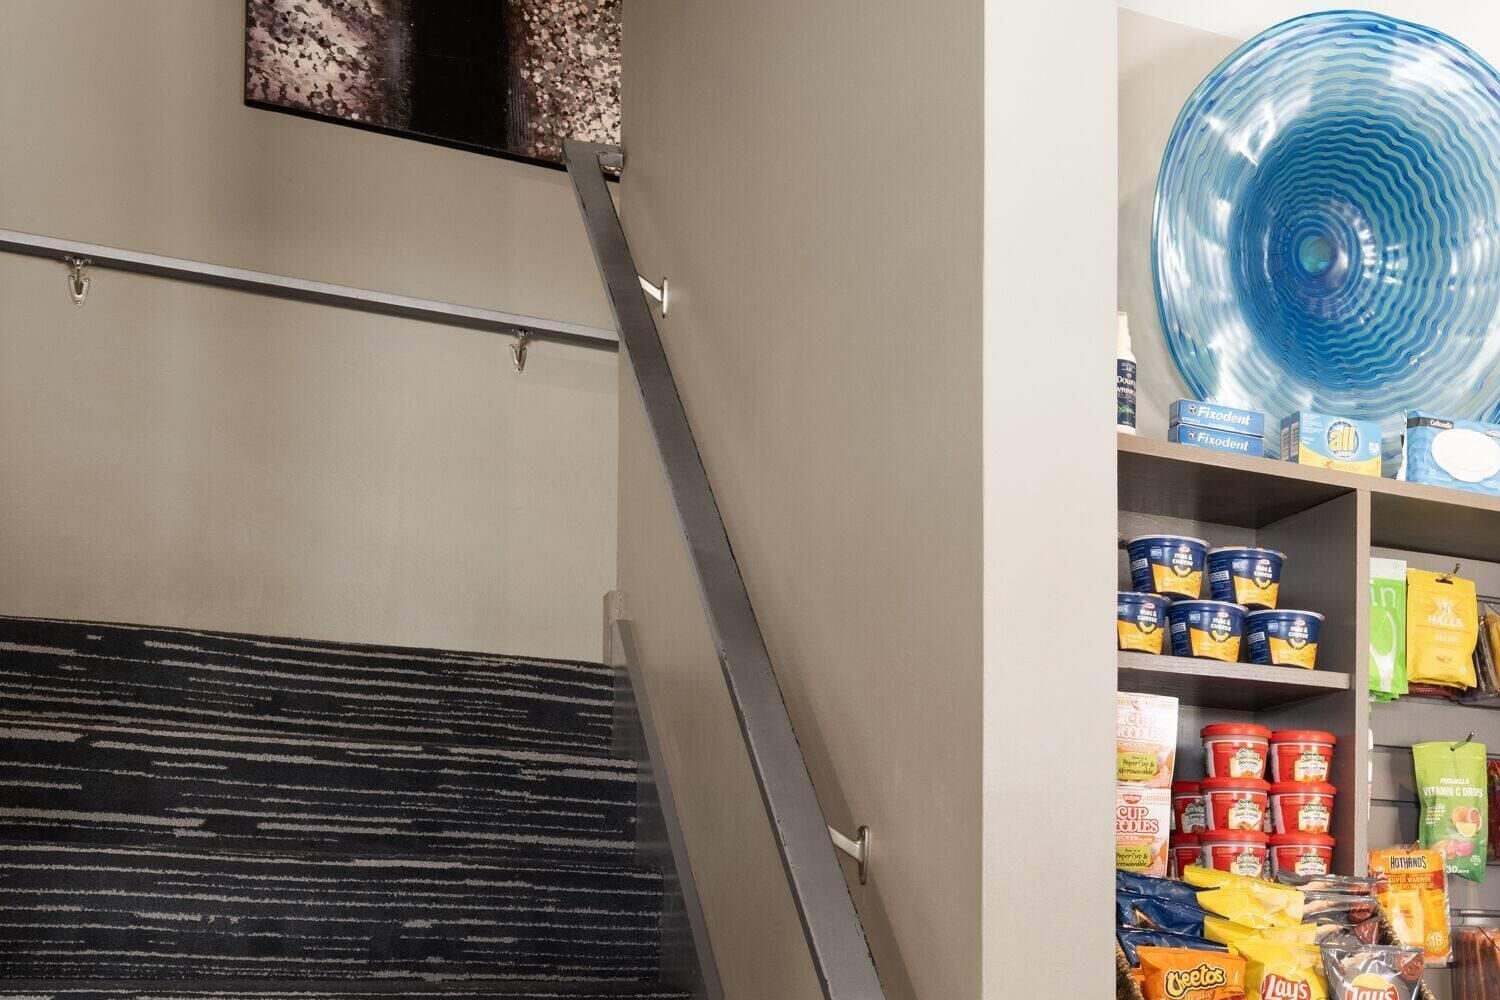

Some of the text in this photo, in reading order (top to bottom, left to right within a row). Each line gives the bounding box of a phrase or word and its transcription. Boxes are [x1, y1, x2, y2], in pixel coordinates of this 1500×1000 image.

[1198, 405, 1251, 426] Fixodent
[1197, 432, 1249, 451] Fixodent
[1329, 426, 1356, 451] all
[1427, 614, 1463, 628] HALLS
[1423, 786, 1483, 798] VITAMIN C DROPS
[1116, 806, 1149, 820] CUP
[1390, 855, 1427, 870] HOTHANDS
[1446, 865, 1457, 873] 30
[1432, 935, 1440, 945] 18
[1165, 963, 1225, 998] Cheetos
